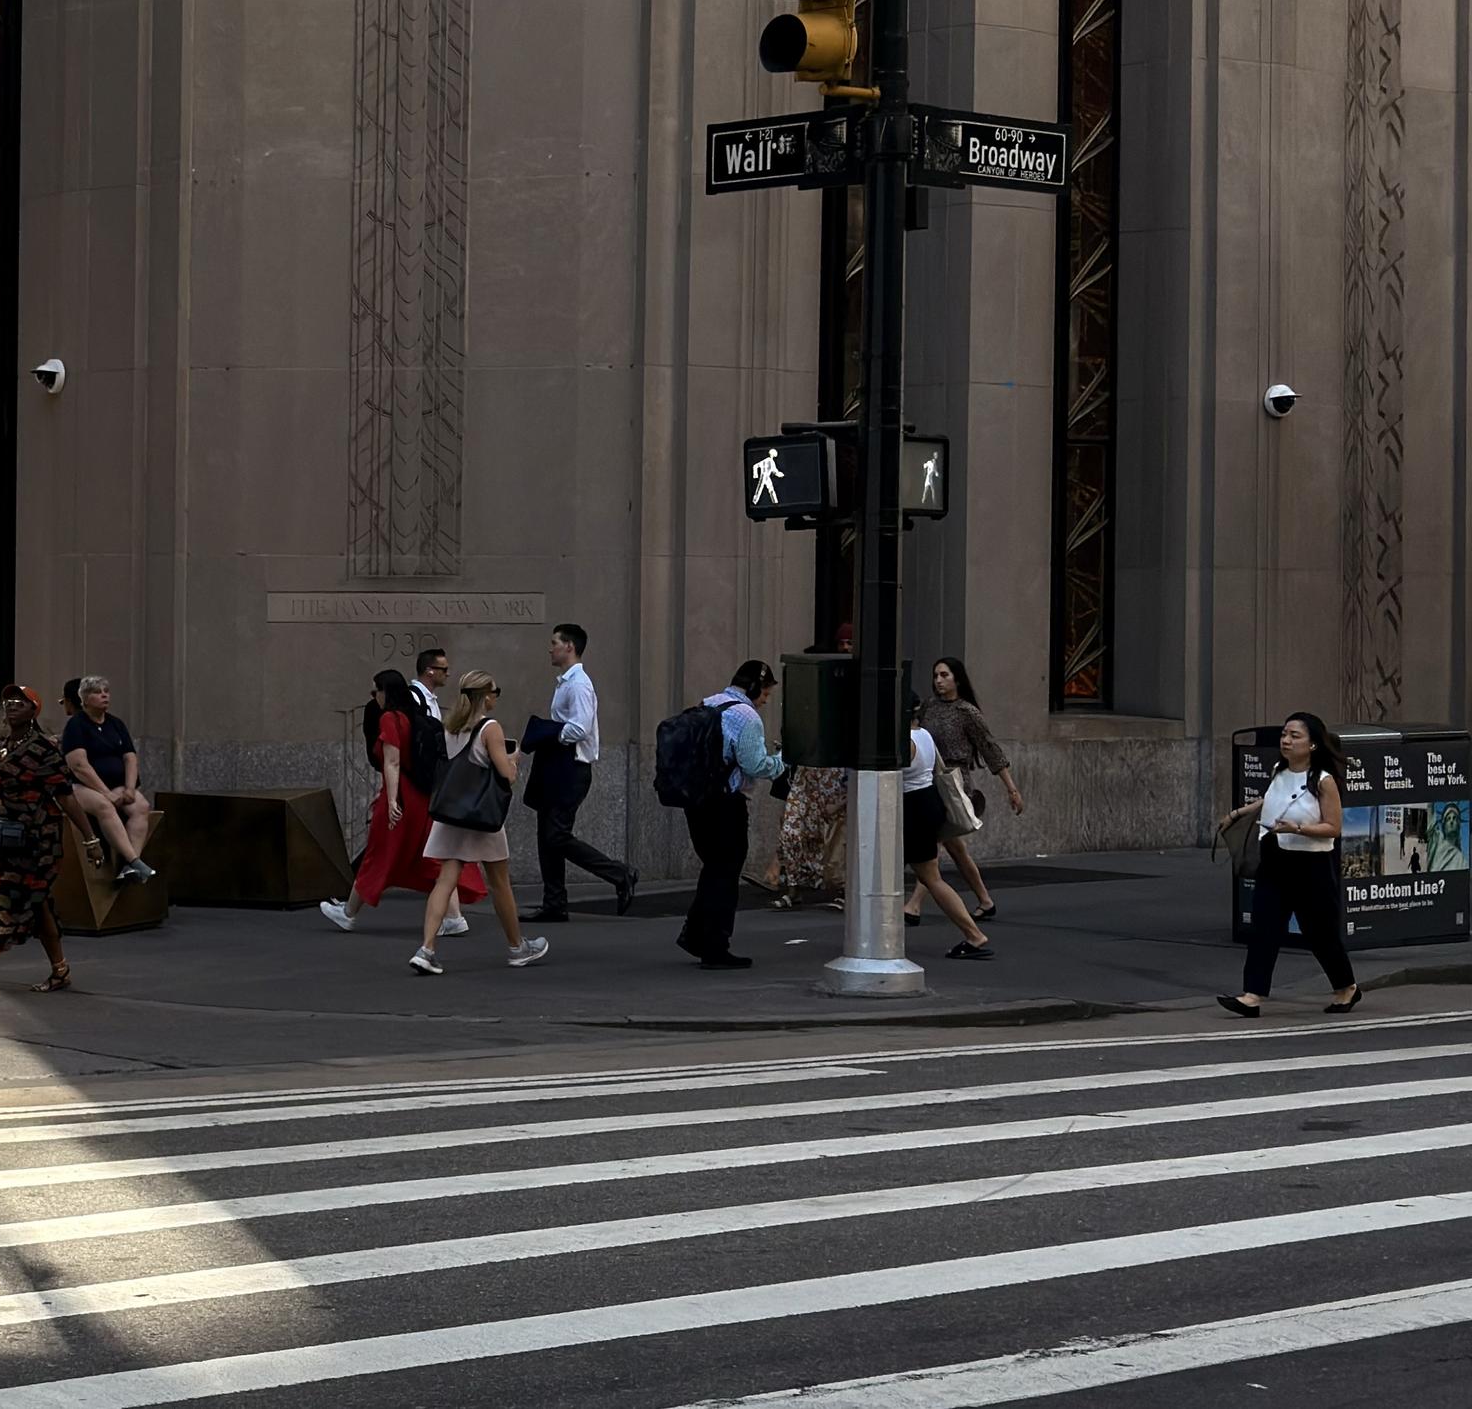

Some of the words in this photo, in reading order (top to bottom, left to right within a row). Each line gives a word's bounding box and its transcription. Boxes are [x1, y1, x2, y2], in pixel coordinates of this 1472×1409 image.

[759, 129, 773, 140] 1-21
[995, 128, 1023, 143] 60-90
[726, 140, 772, 174] Wall
[969, 137, 1057, 179] Broadway
[977, 165, 1005, 176] CANYON
[1008, 169, 1017, 177] OF
[1020, 170, 1046, 181] HEROES
[291, 598, 328, 616] THE
[335, 598, 388, 616] BANK
[392, 598, 420, 616] OF
[426, 598, 471, 616] NEW
[480, 598, 535, 616] YORK
[1244, 754, 1259, 762] The
[1384, 755, 1399, 766] The
[1427, 752, 1442, 763] The
[1244, 762, 1262, 770] best
[1427, 763, 1446, 774] best
[1447, 762, 1456, 774] of
[1346, 767, 1365, 779] best
[1384, 767, 1403, 778] best
[1346, 780, 1373, 791] views.
[1384, 778, 1414, 790] transit.
[1427, 775, 1445, 786] New
[1447, 774, 1467, 785] York.
[1244, 787, 1259, 795] The
[1346, 886, 1368, 901] The
[1370, 883, 1412, 899] Bottom
[1414, 879, 1445, 896] Line?
